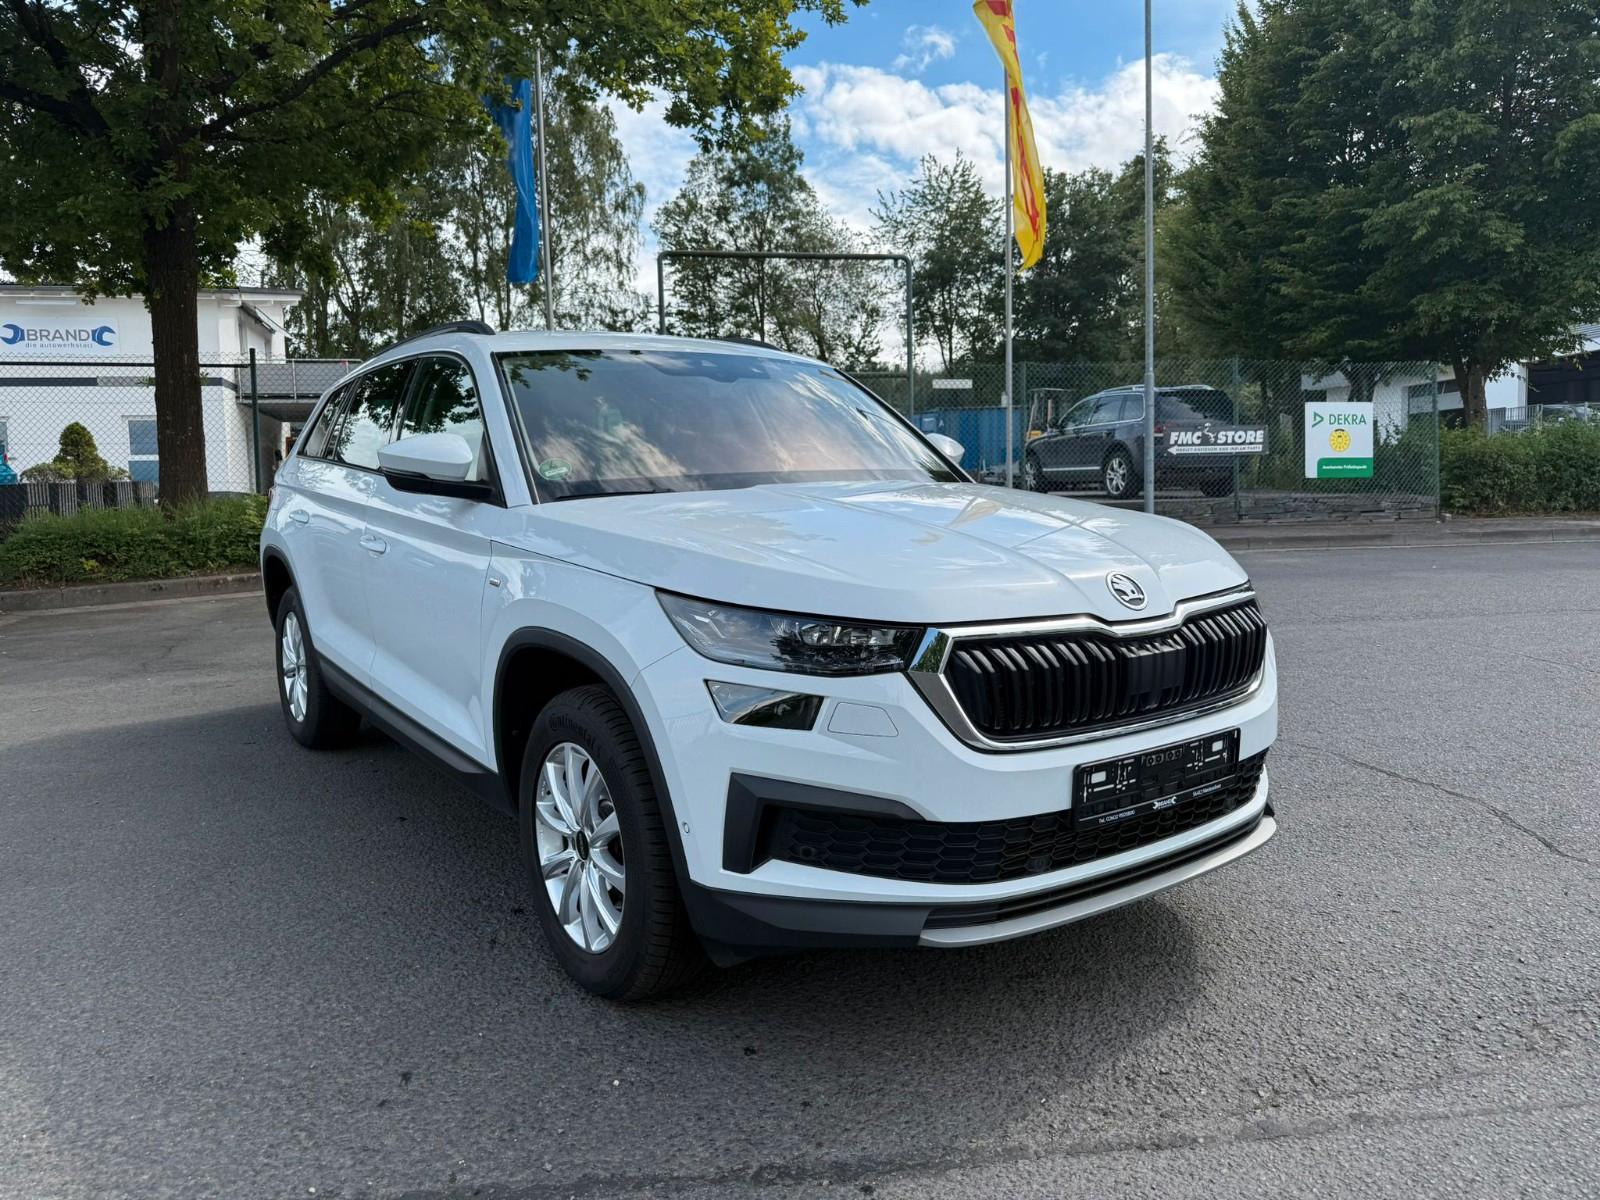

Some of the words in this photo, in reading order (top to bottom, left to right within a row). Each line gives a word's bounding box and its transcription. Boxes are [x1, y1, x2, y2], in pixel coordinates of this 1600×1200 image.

[26, 329, 90, 341] BRAND
[1328, 414, 1366, 425] DEKRA
[1170, 431, 1202, 445] FMC
[1217, 430, 1264, 444] STORE
